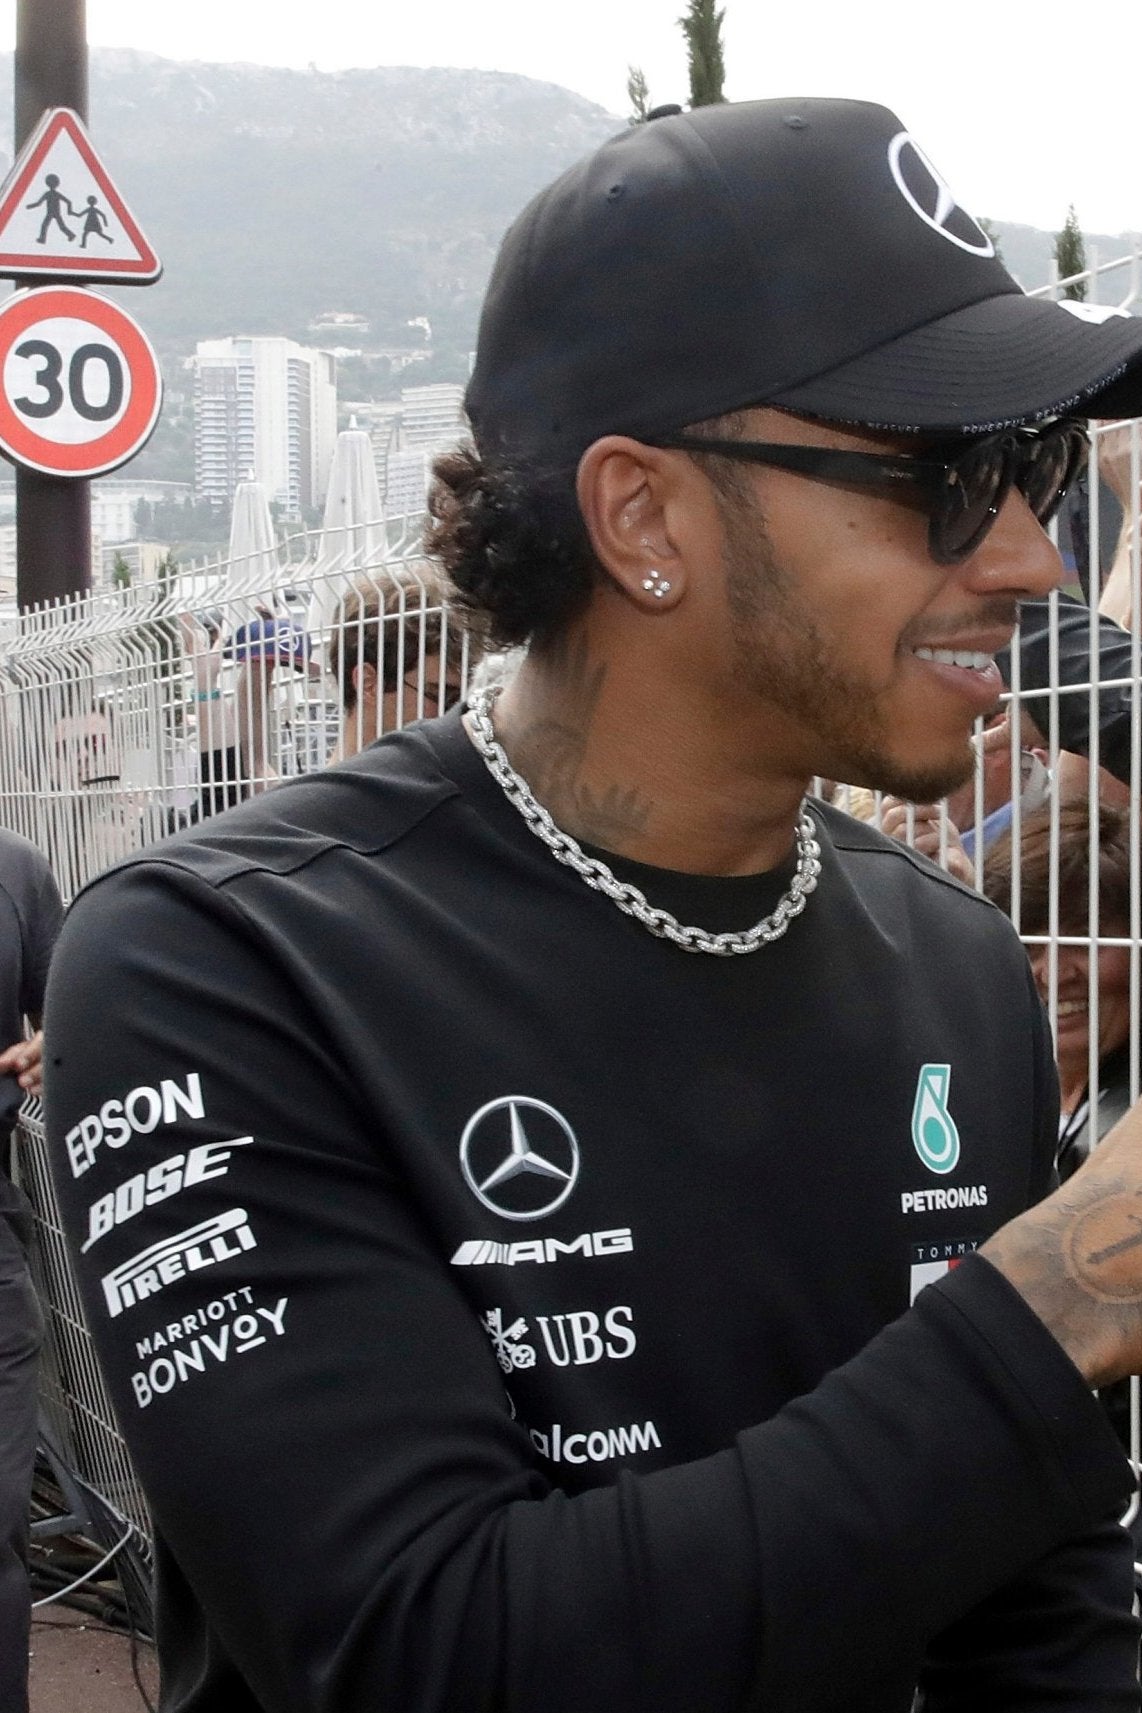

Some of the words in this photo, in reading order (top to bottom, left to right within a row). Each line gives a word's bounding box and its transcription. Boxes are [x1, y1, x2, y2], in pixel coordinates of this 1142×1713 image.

[13, 339, 124, 422] 30
[64, 1072, 206, 1179] EPSON
[80, 1135, 255, 1255] BOSE
[900, 1184, 989, 1214] PETRONAS
[101, 1207, 258, 1319] PIRELLI
[508, 1228, 634, 1266] AMG
[917, 1241, 978, 1260] TOMMY
[131, 1297, 289, 1409] BONVOY
[135, 1285, 254, 1361] MARRIOTT
[535, 1305, 638, 1367] UBS
